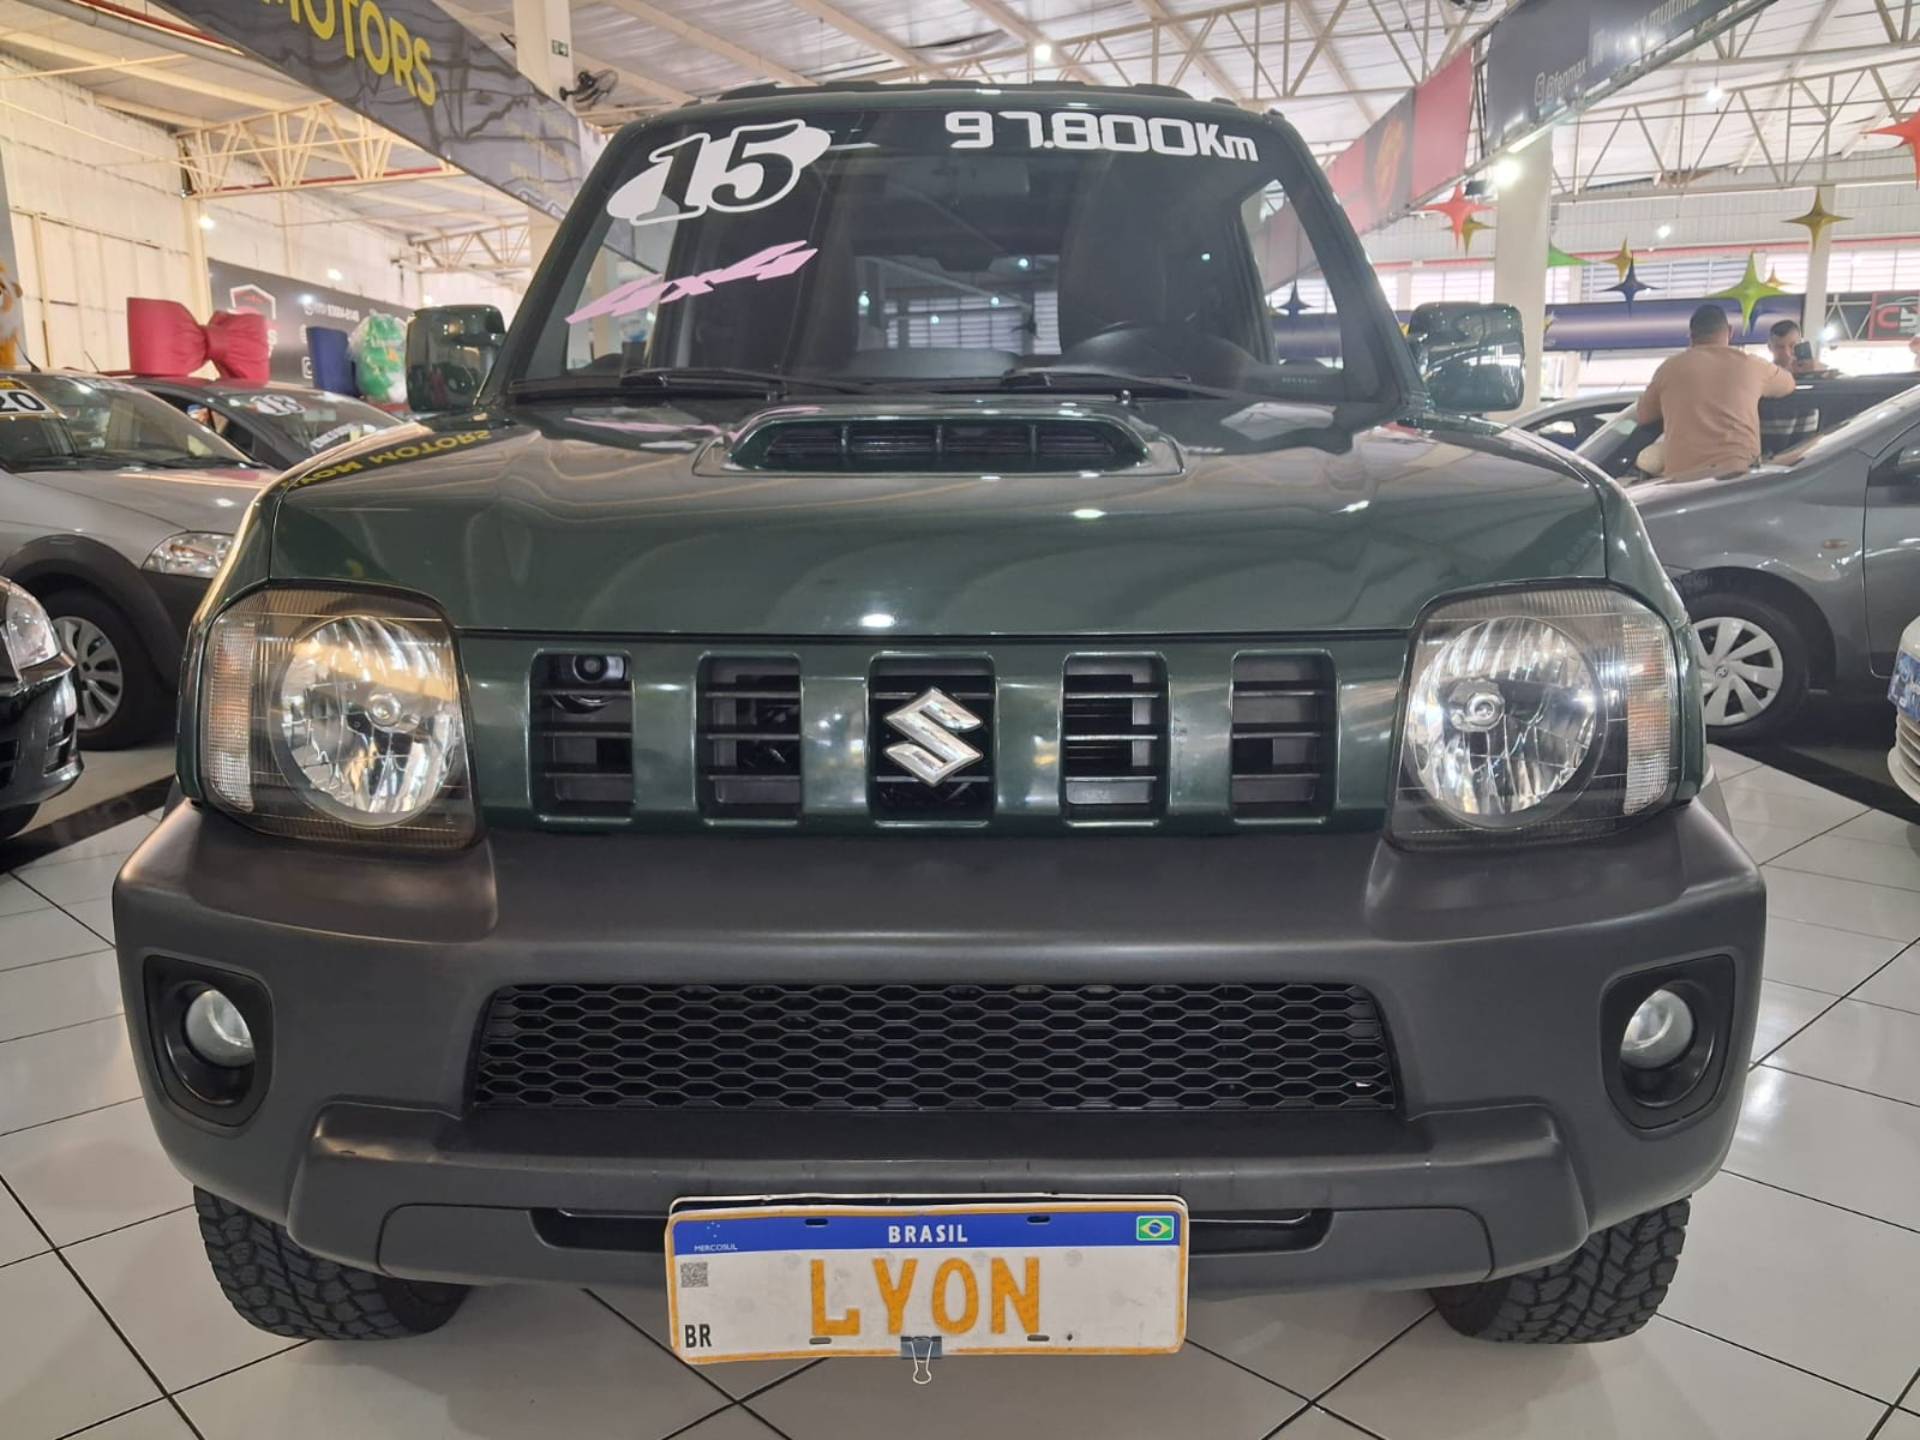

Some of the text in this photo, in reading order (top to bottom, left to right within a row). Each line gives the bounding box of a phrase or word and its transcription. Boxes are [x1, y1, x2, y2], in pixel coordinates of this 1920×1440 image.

[262, 0, 436, 106] OTORS
[630, 118, 807, 226] 15
[693, 1243, 738, 1252] MERCOSUL
[888, 1224, 968, 1244] BRASIL
[810, 1256, 1040, 1336] LYON
[684, 1324, 712, 1349] BR
